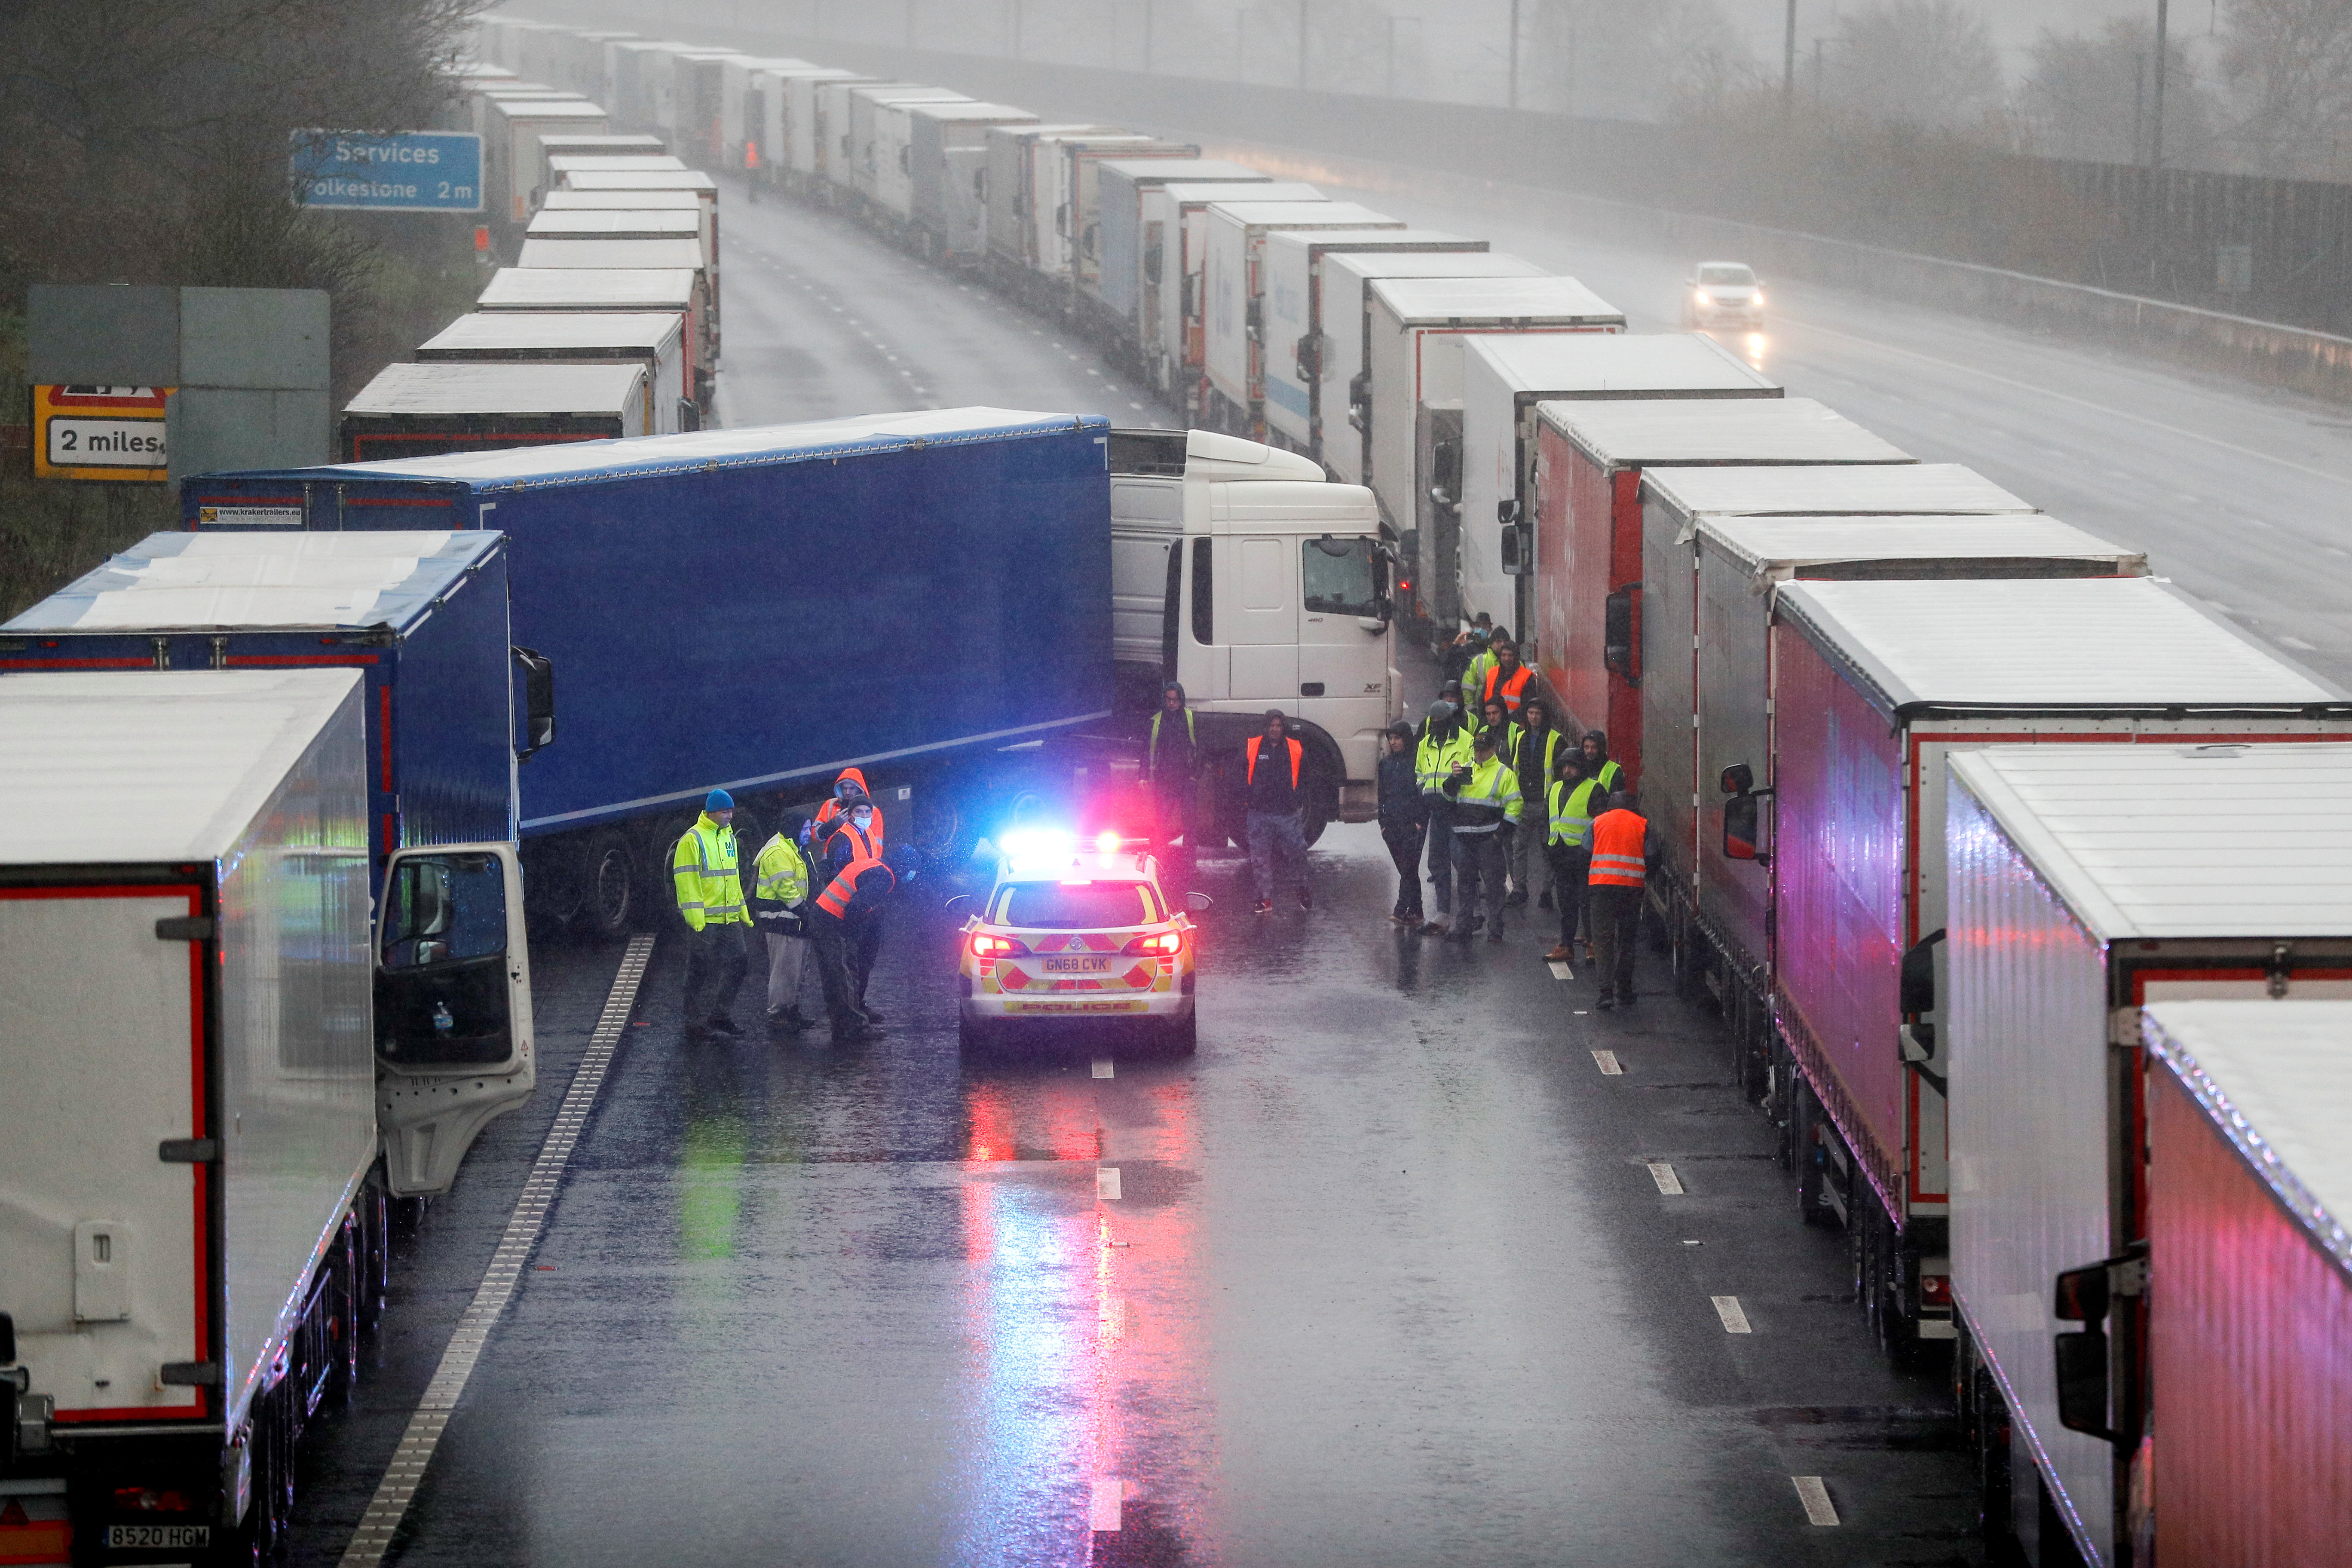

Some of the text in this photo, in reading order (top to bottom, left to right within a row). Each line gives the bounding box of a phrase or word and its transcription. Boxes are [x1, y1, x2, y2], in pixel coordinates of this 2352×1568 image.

[336, 141, 440, 164] Services
[307, 178, 472, 199] olkestone 2 m
[61, 430, 159, 452] 2 miles
[1046, 958, 1106, 971] GN68 CVK
[113, 1528, 206, 1546] 8520 HGM
